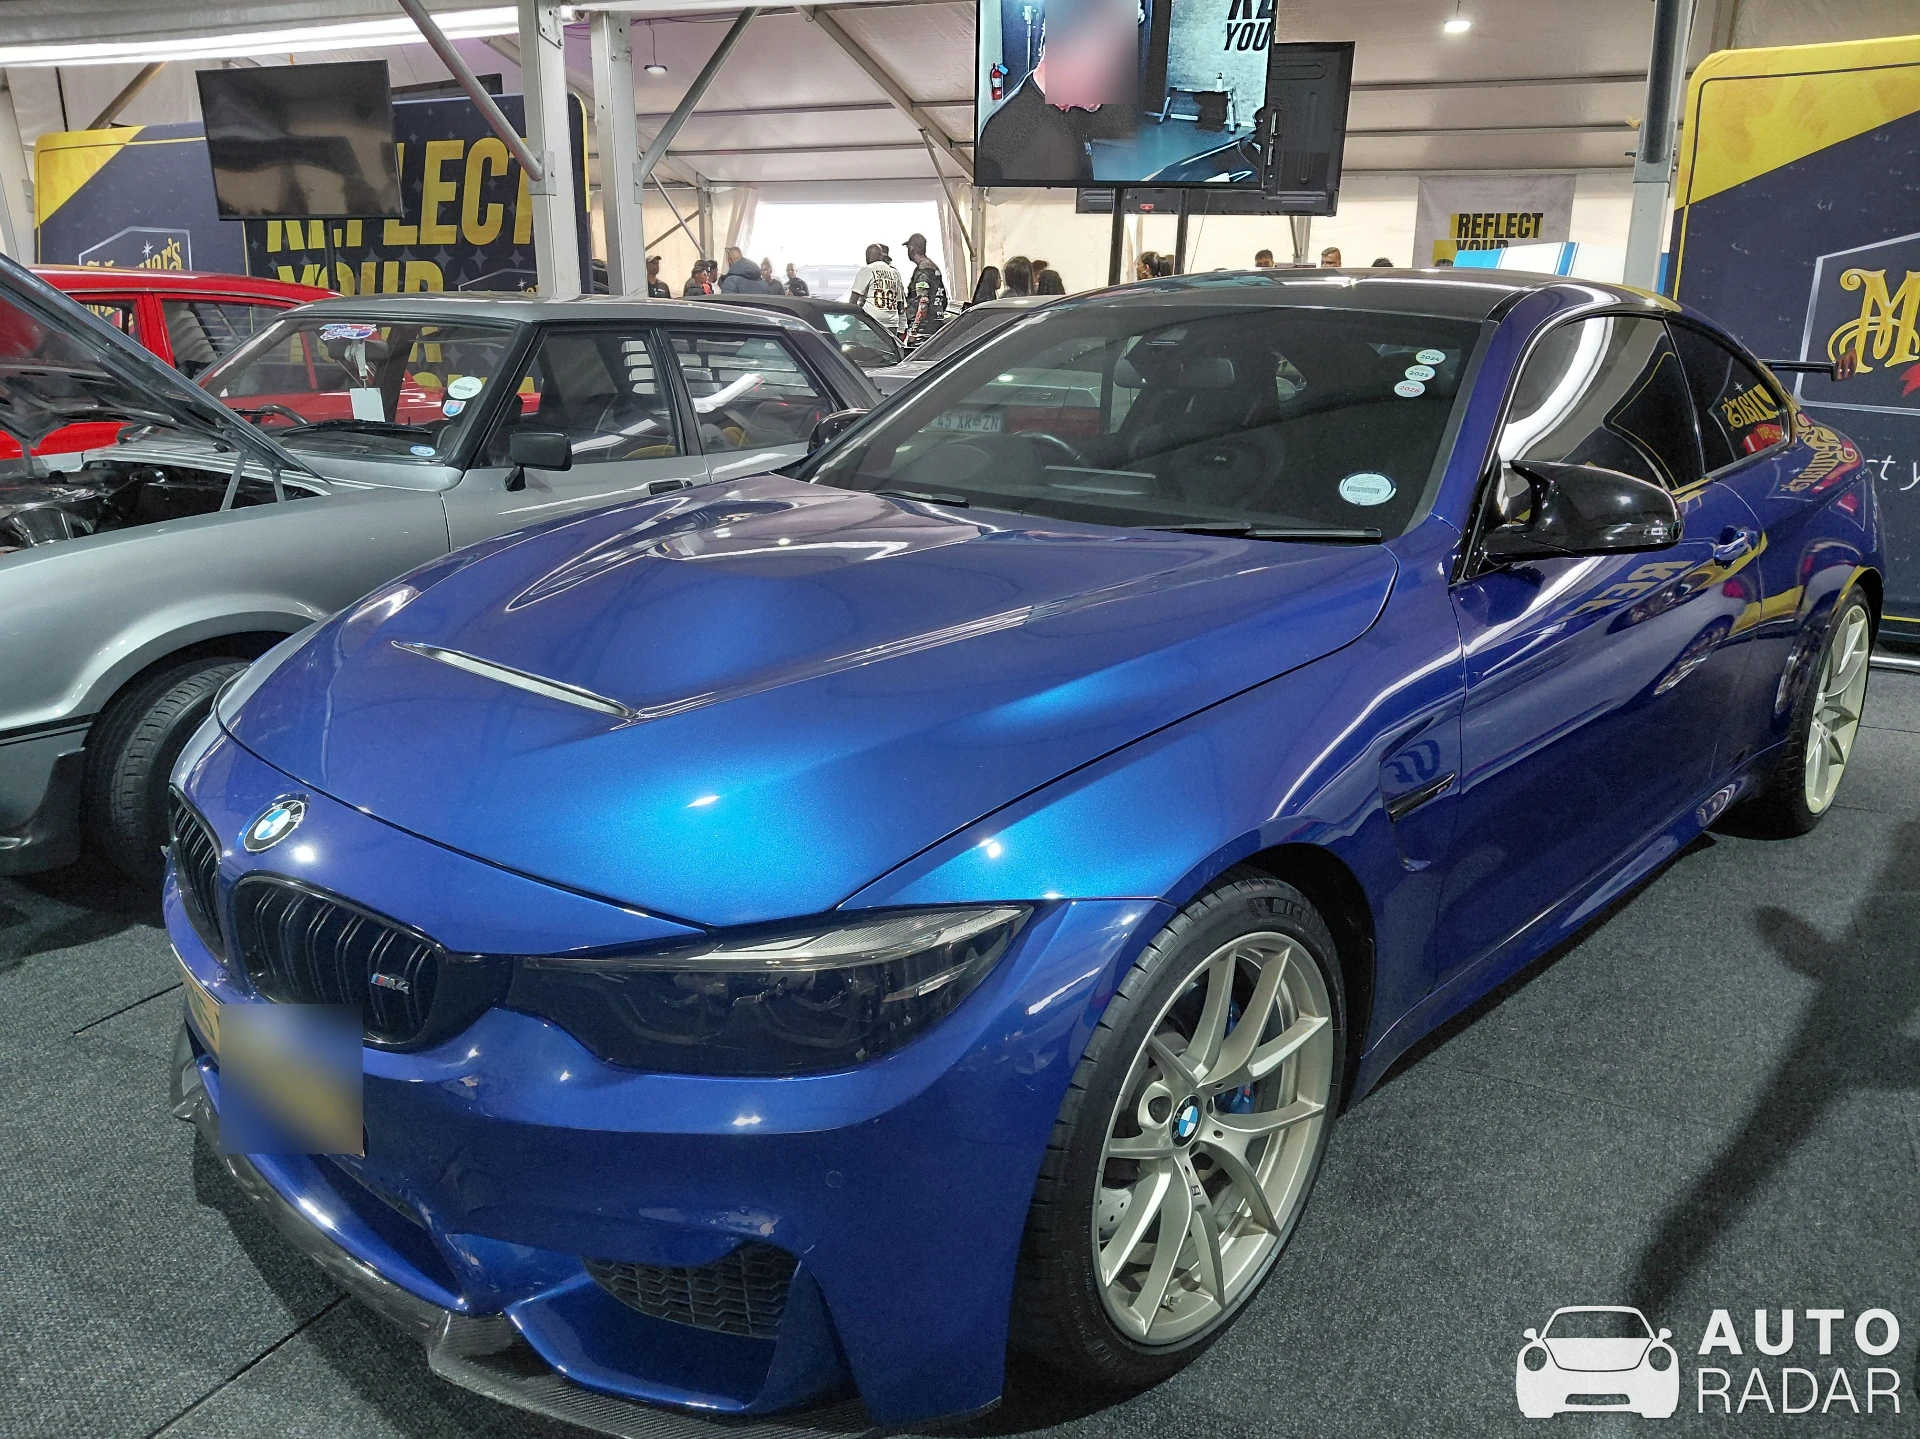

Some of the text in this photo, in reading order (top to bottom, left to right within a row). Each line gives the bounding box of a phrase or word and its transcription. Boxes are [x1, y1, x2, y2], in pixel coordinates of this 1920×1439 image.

[1457, 212, 1544, 238] REFLECT
[1420, 354, 1440, 362] 2024
[1409, 370, 1429, 378] 2025
[1398, 385, 1420, 394] 2026
[983, 414, 999, 431] ZN
